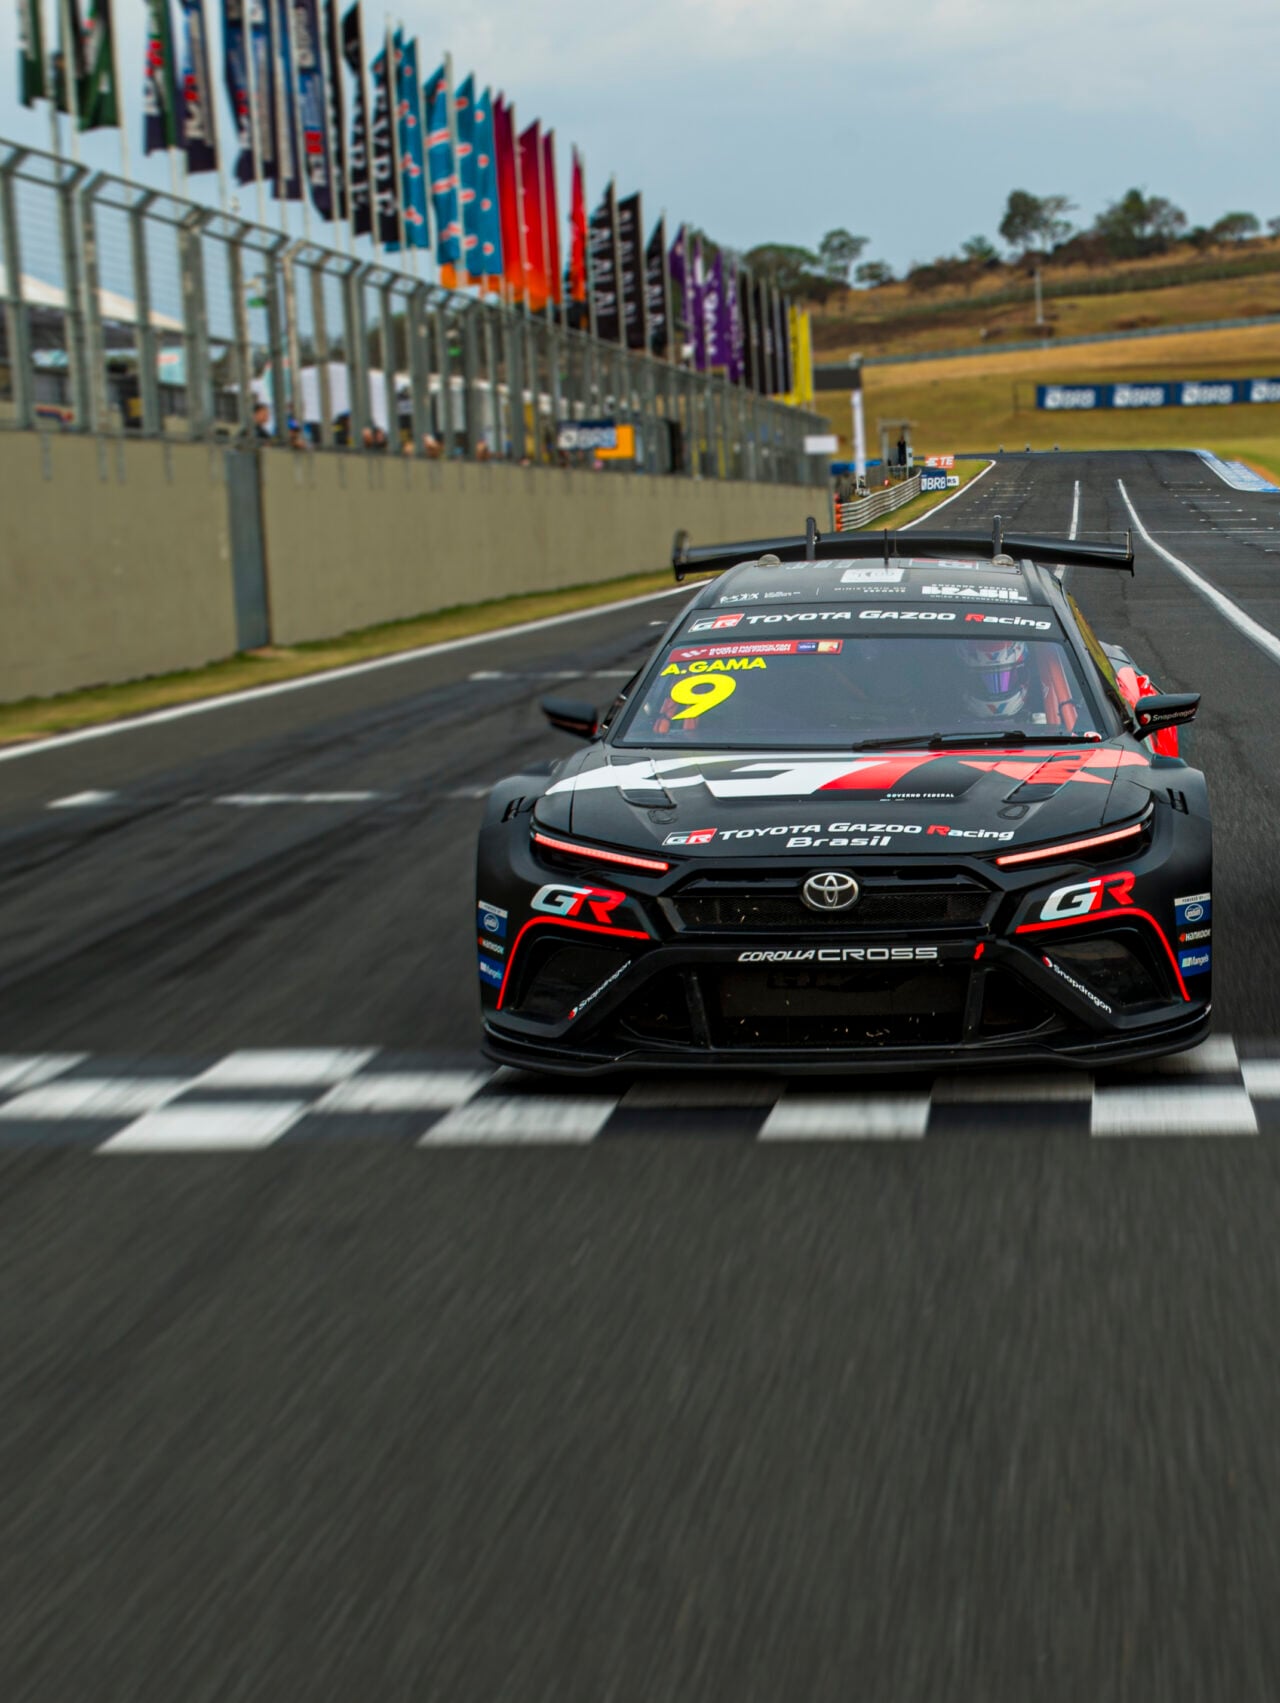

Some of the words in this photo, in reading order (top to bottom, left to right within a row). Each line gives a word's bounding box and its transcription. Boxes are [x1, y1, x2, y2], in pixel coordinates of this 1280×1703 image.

[928, 477, 946, 490] BRB
[746, 611, 851, 625] TOYOTA
[858, 610, 956, 621] GAZOO
[964, 613, 1051, 630] Racing
[660, 657, 767, 676] A.GAMA
[670, 673, 737, 721] 9
[664, 831, 714, 846] GR
[719, 824, 821, 841] TOYOTA
[827, 822, 922, 835] GAZOO
[926, 824, 1015, 841] Racing
[786, 835, 892, 849] Brasil
[530, 884, 627, 924] GR
[1040, 870, 1136, 921] GR
[738, 949, 815, 962] COROLLA
[817, 946, 938, 961] CROSS
[1053, 964, 1112, 1014] Snapdragon
